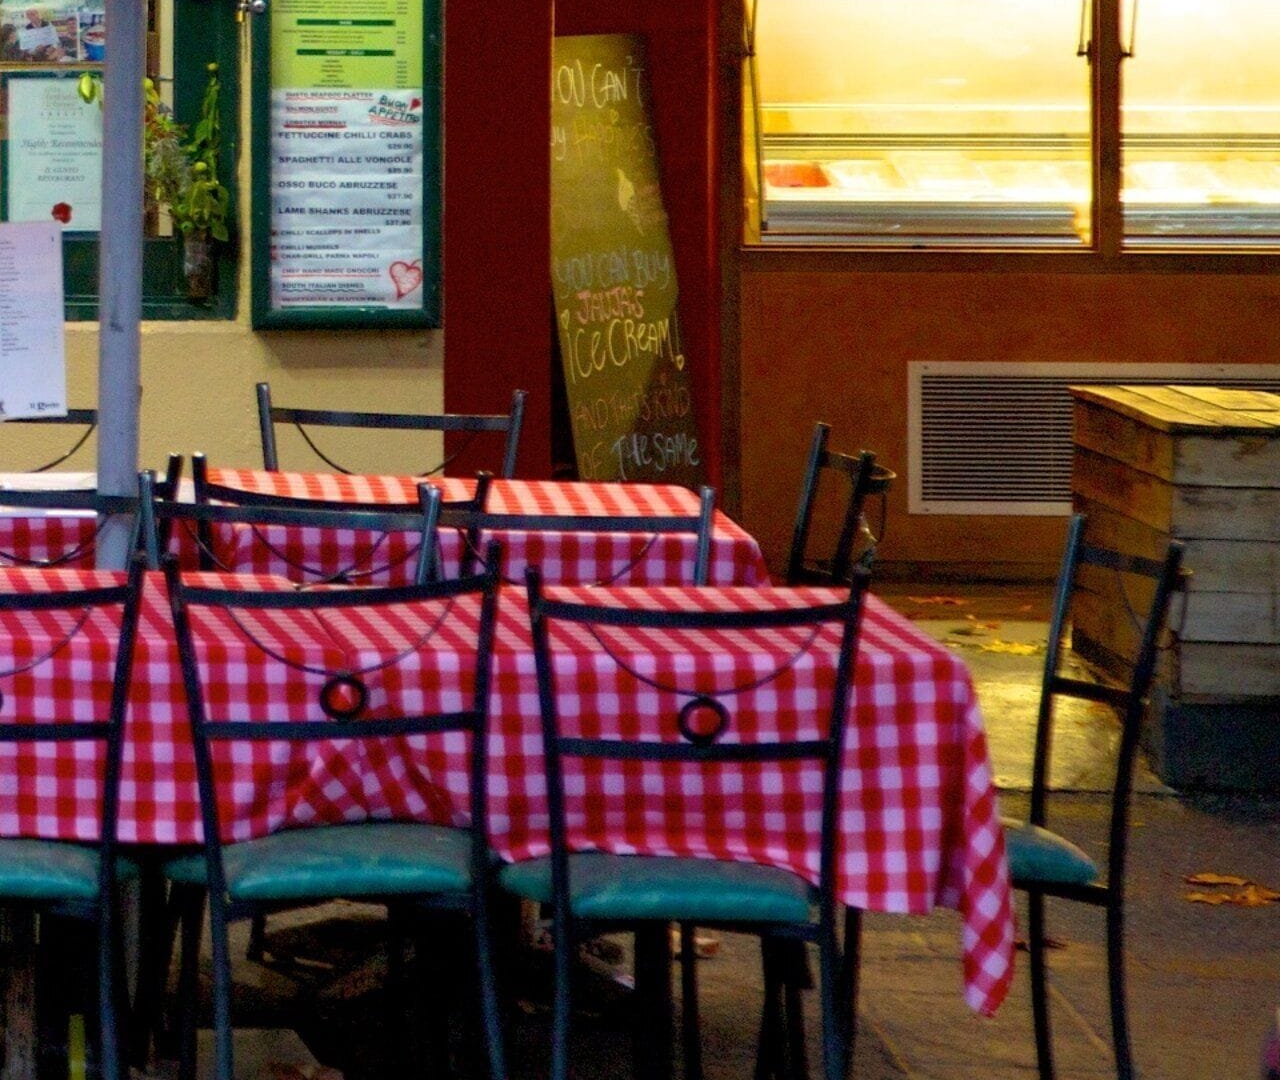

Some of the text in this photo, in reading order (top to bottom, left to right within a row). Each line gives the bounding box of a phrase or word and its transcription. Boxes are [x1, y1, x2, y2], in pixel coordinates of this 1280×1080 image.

[557, 59, 585, 107] OU
[278, 131, 340, 139] FETTUCCINE
[337, 156, 362, 164] ALLE
[365, 156, 412, 164] VONGOLE
[279, 181, 305, 189] OSSO
[308, 181, 336, 189] BUCO
[308, 207, 350, 215] SHANKS
